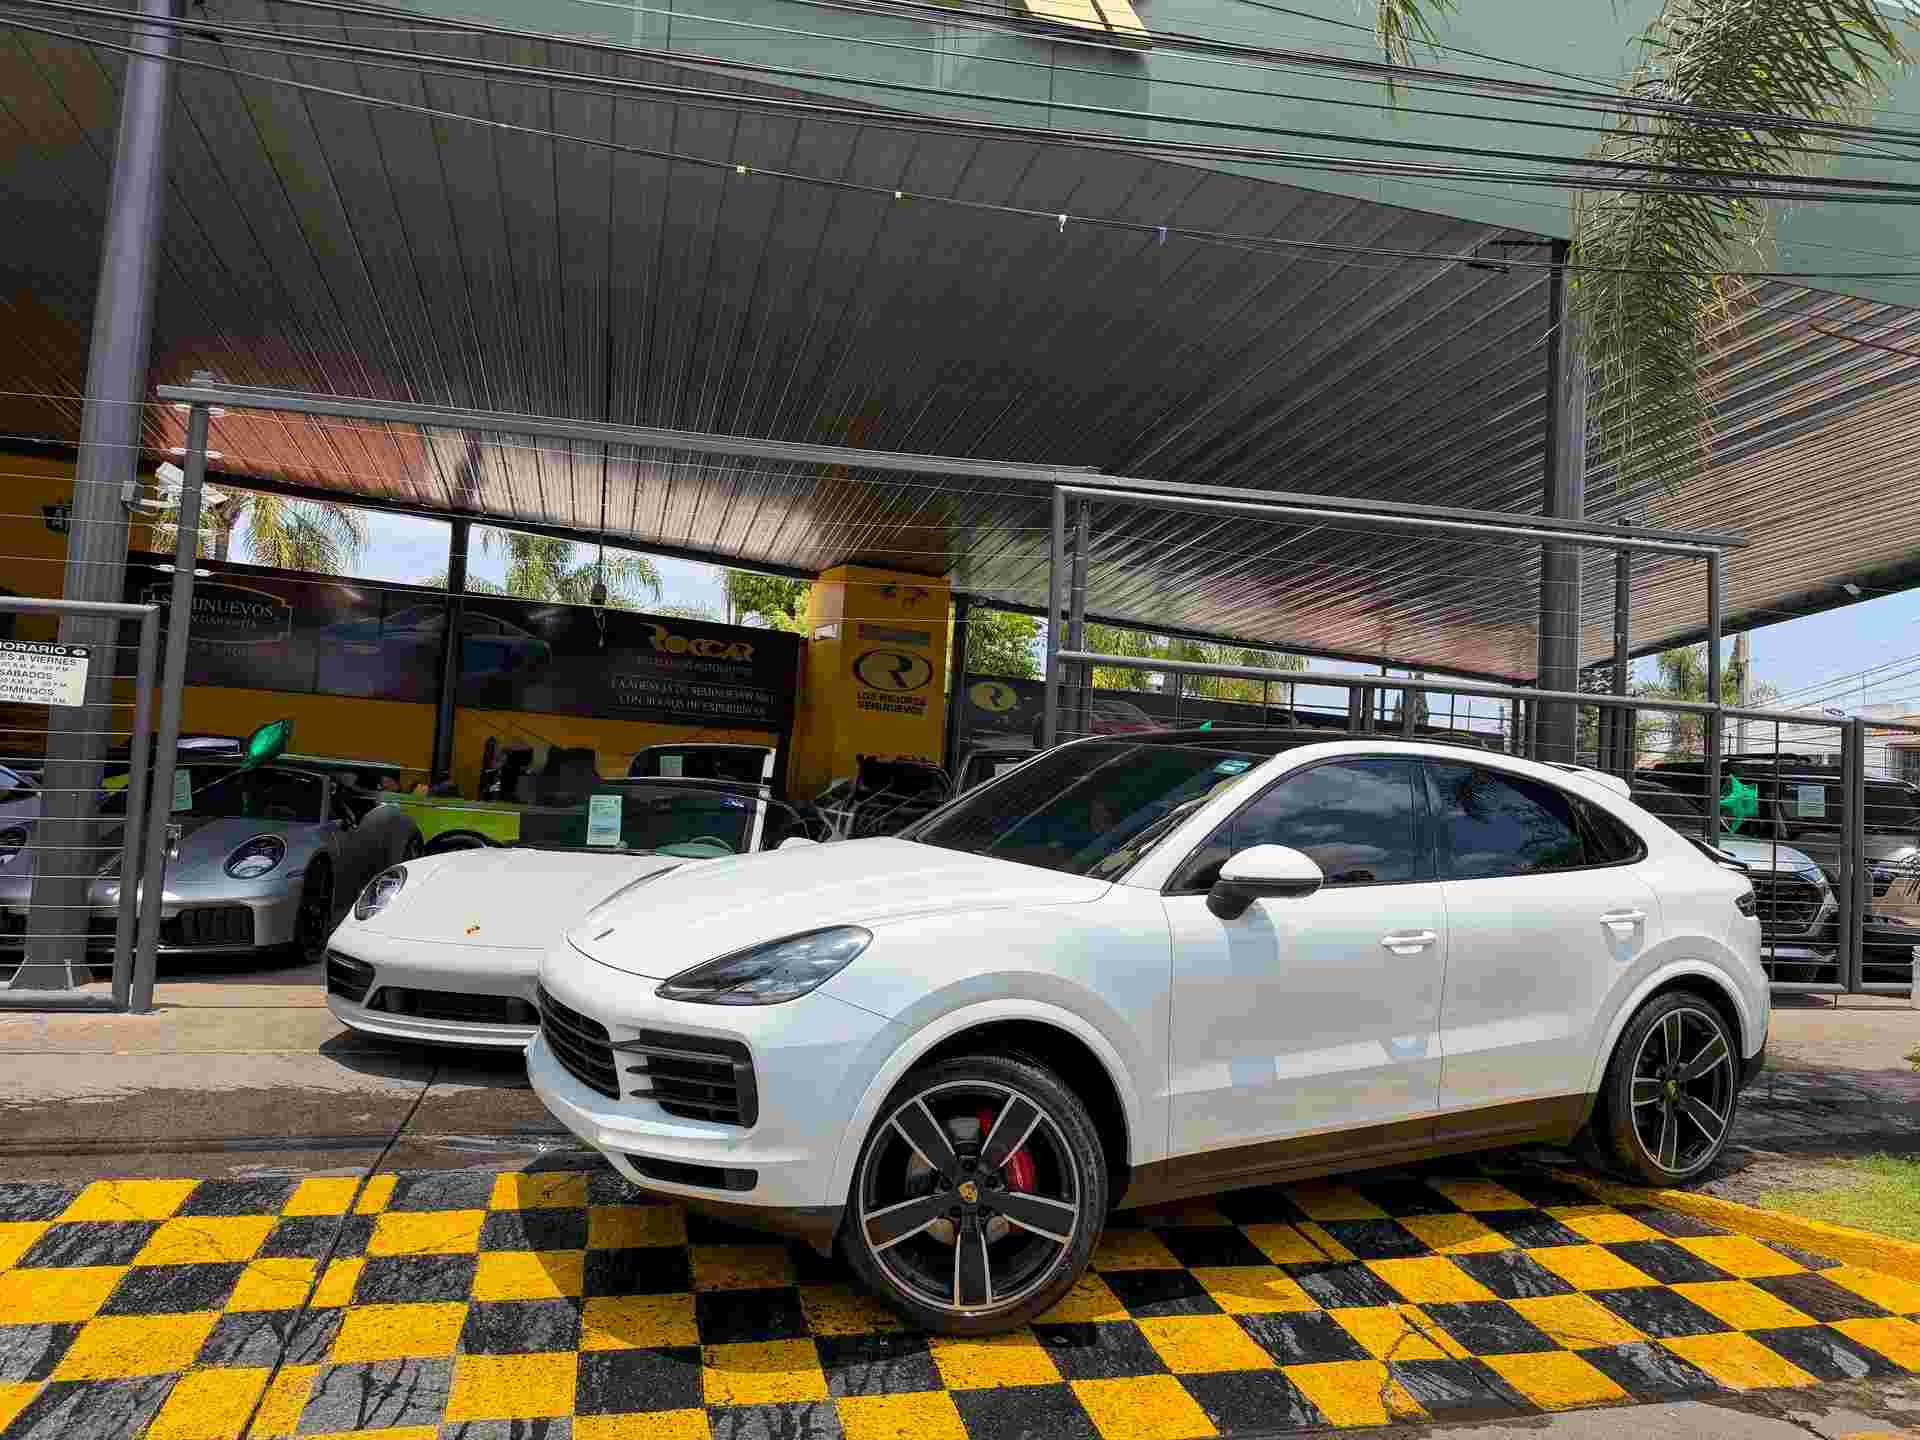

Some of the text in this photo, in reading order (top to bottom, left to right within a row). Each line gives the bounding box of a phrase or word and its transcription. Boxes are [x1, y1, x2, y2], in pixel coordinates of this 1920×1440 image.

[161, 593, 273, 617] SINUEVOS
[0, 641, 67, 655] ORARIO
[30, 655, 77, 666] VIERNES
